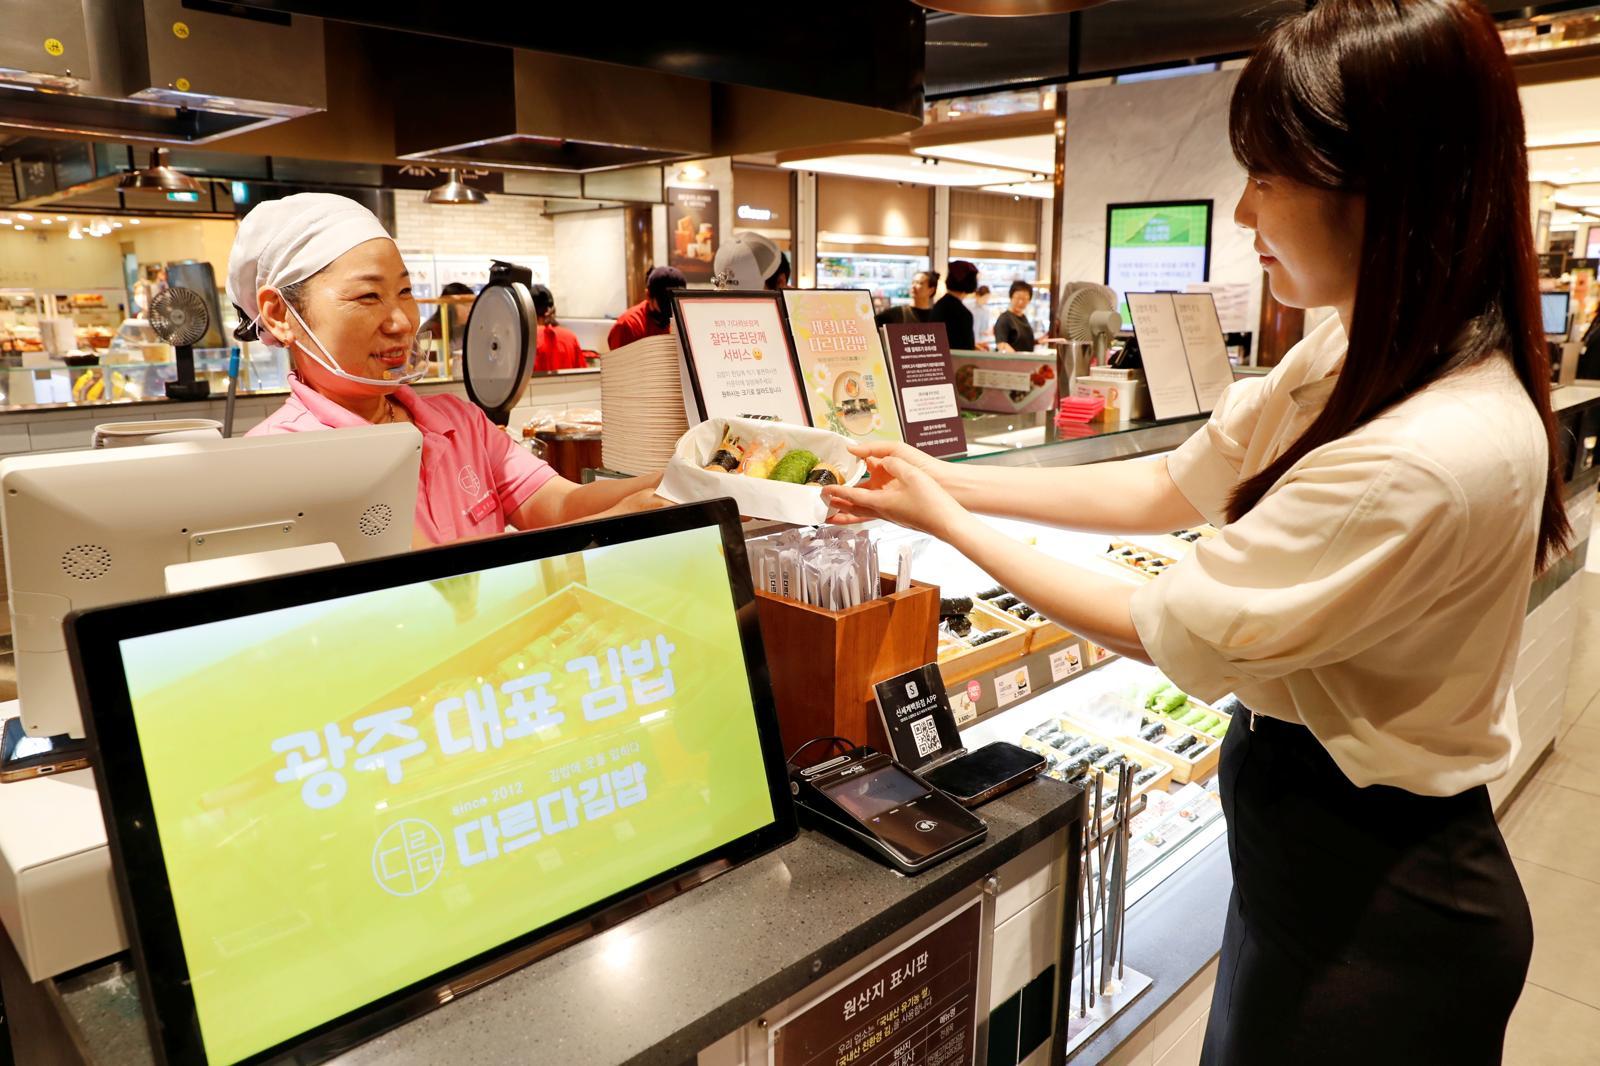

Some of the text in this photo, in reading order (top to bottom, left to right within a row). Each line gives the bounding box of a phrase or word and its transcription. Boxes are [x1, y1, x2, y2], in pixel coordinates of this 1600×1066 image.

[710, 331, 767, 346] 잘라드린당께
[723, 348, 752, 361] 서비스
[926, 694, 937, 705] APP
[272, 634, 676, 809] 광주 대표 김밥
[452, 781, 524, 816] since 2012
[453, 761, 647, 867] 다르다김밥
[843, 951, 928, 1021] 원산지 표시판
[838, 1039, 853, 1055] 우리
[893, 1040, 911, 1059] 원산지
